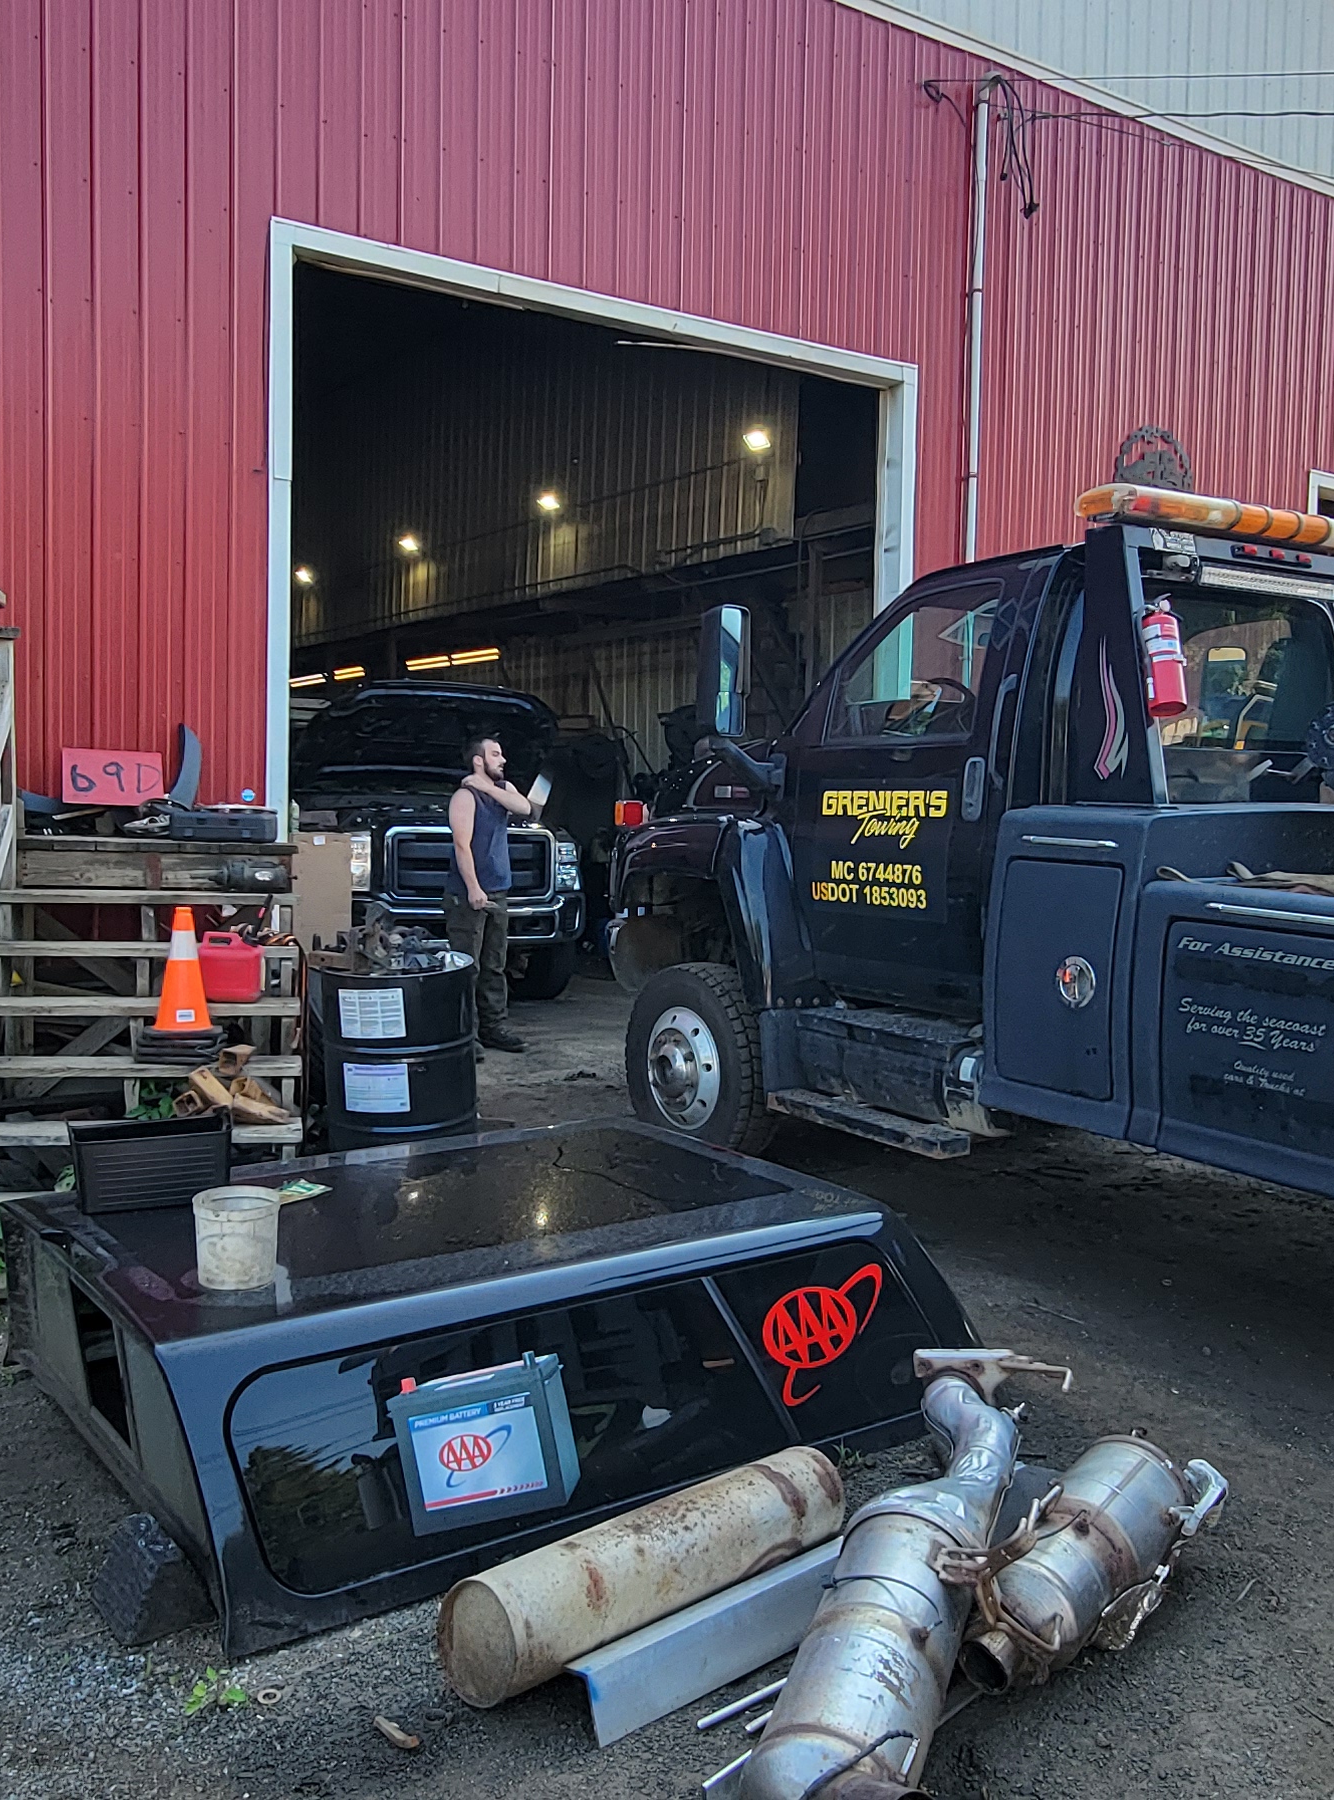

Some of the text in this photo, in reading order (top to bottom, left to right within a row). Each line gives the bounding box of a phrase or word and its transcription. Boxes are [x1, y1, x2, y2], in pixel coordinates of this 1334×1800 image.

[822, 790, 948, 818] GRENIER'S
[850, 810, 919, 849] Towing
[831, 860, 922, 885] MC 6744876
[811, 881, 927, 910] USDOT 1853093
[1177, 936, 1212, 952] For
[1178, 997, 1327, 1038] Serving the seacoast
[1186, 1016, 1317, 1053] for over 35 Years
[771, 1289, 851, 1365] AAA
[414, 1407, 482, 1429] PREMIUM BATTERY
[443, 1436, 489, 1470] AAA
